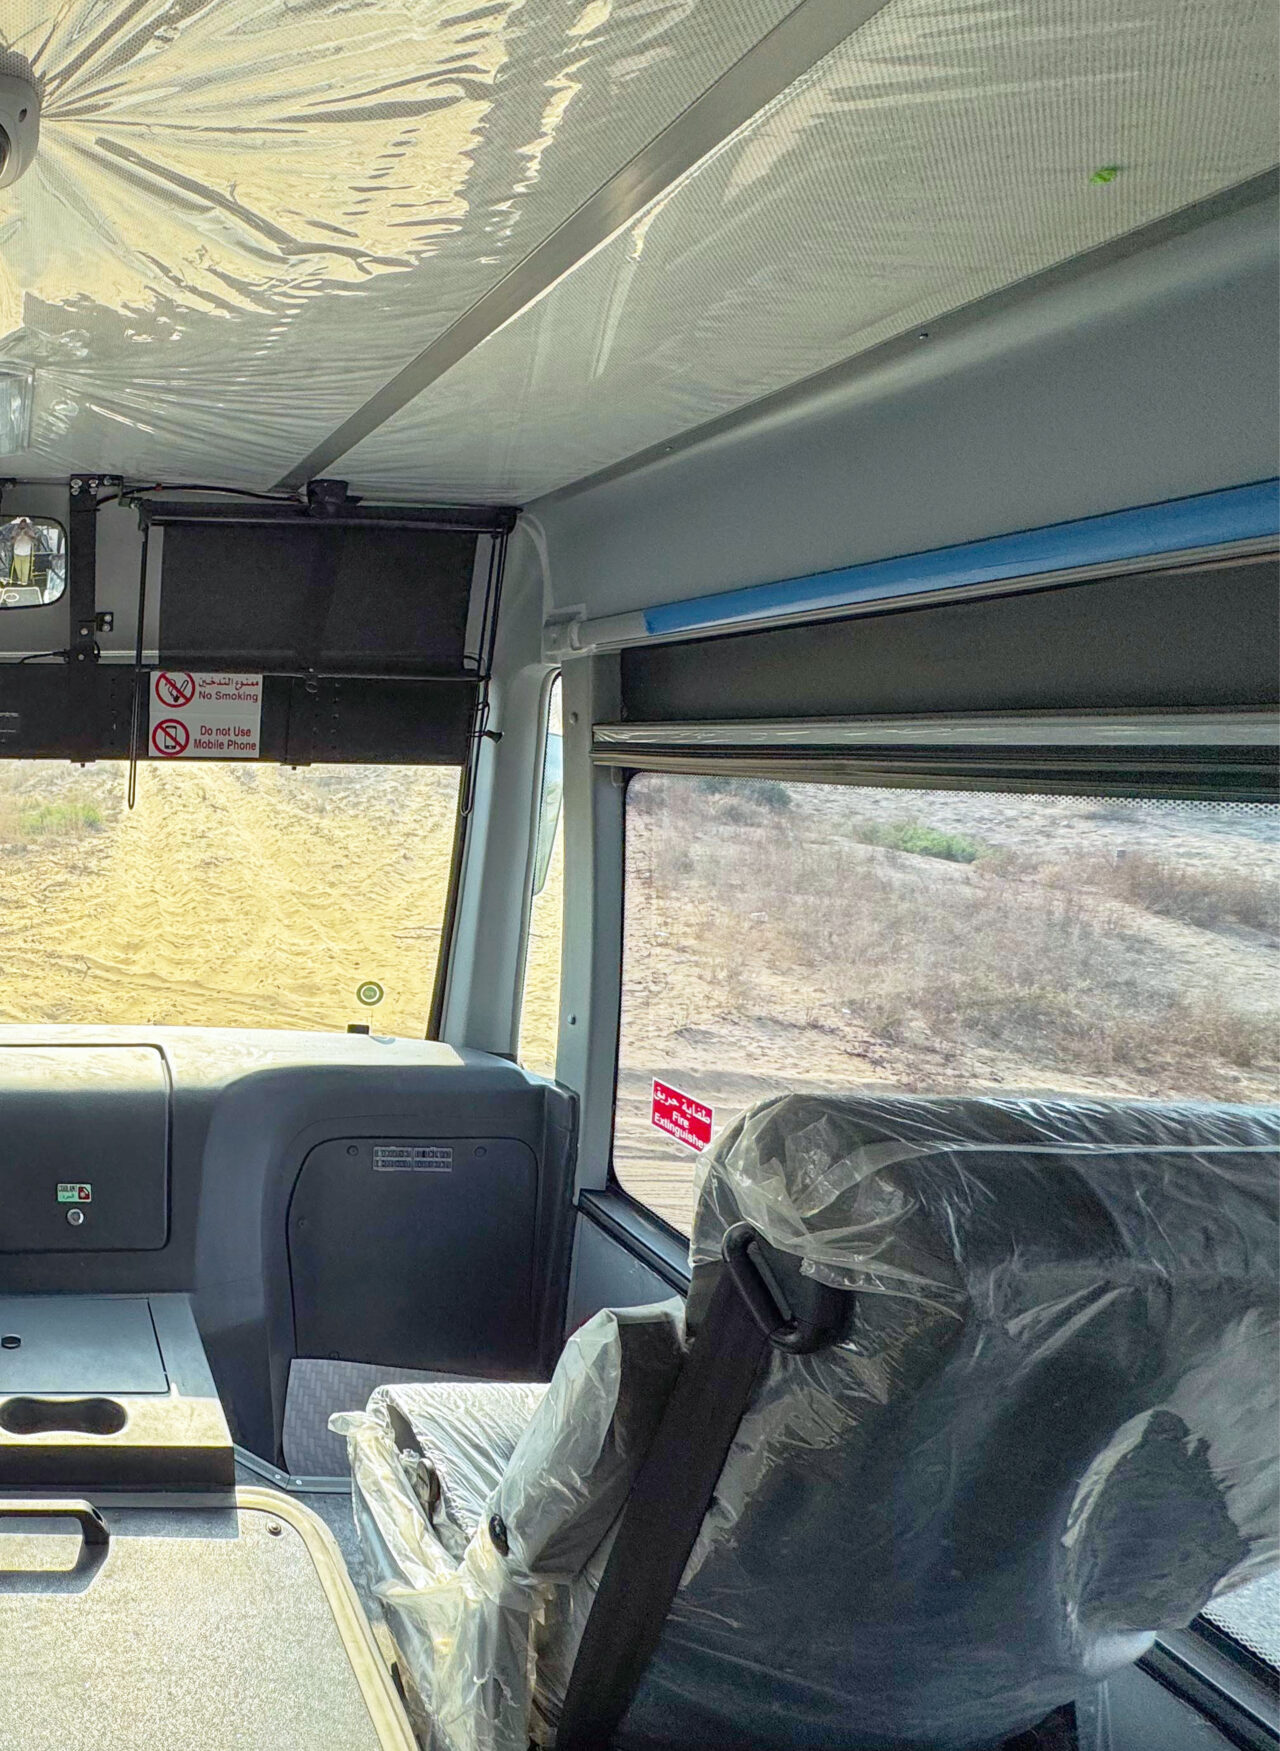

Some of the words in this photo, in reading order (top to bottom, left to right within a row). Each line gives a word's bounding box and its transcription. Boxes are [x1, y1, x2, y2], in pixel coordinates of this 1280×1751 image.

[198, 676, 234, 688] التدخين
[234, 679, 260, 691] ممنوع
[198, 690, 213, 701] No
[215, 691, 259, 704] Smoking
[200, 725, 213, 737] Do
[215, 726, 231, 738] not
[233, 727, 252, 738] Use
[193, 739, 225, 751] Mobile
[227, 742, 257, 751] Phone
[653, 1086, 680, 1106] حريق
[681, 1098, 711, 1124] طفاية
[672, 1110, 690, 1129] Fire
